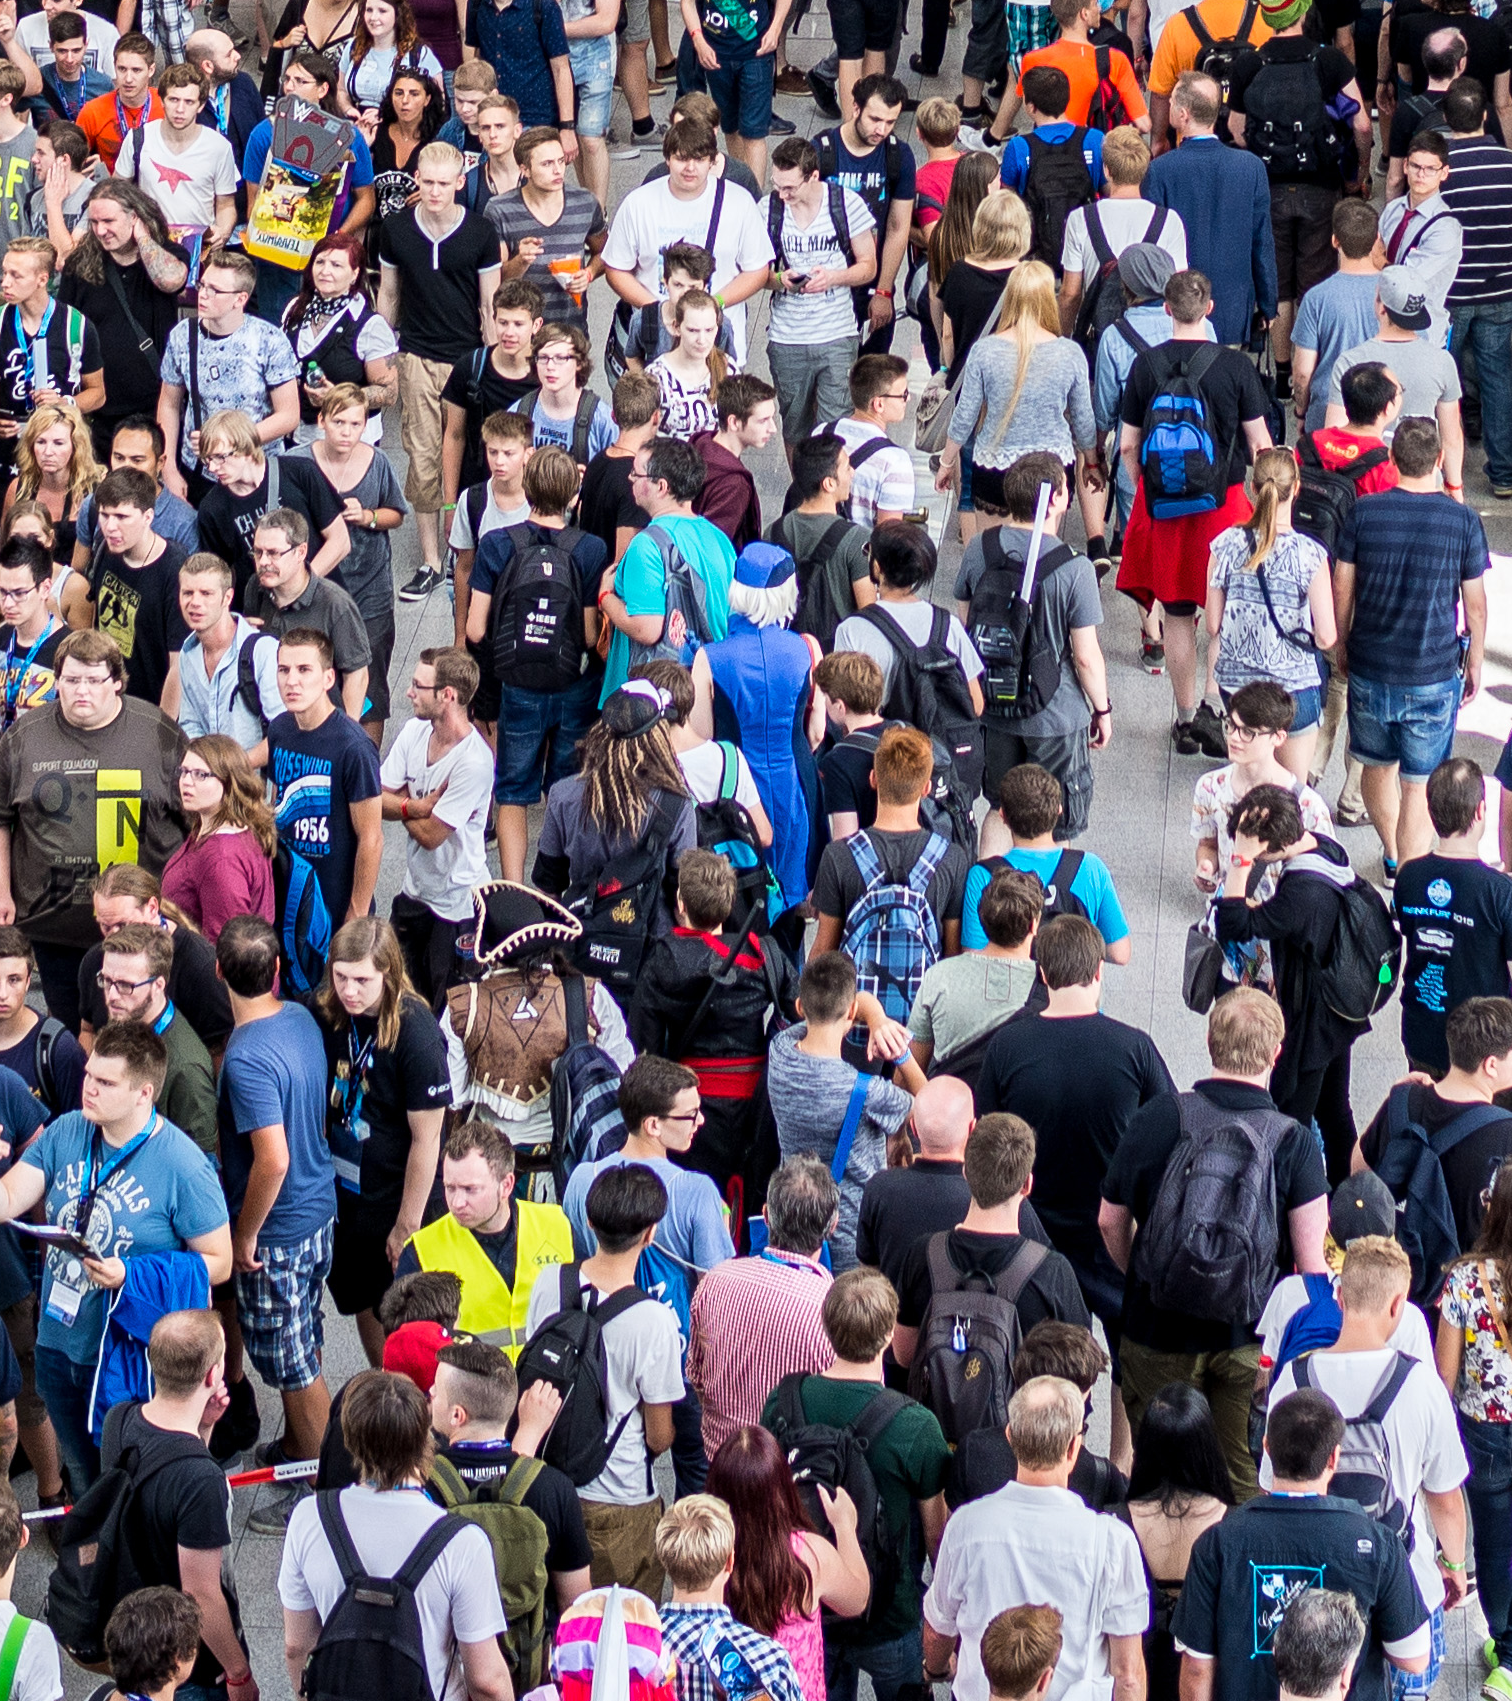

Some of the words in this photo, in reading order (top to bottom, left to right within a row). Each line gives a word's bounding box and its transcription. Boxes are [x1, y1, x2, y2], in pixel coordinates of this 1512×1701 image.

[838, 172, 863, 189] TAKE
[866, 172, 881, 189] ME
[31, 761, 64, 773] SUPPORT
[64, 757, 100, 772] SQUADRON
[293, 817, 330, 843] 1956
[536, 1254, 562, 1265] S.E.C.
